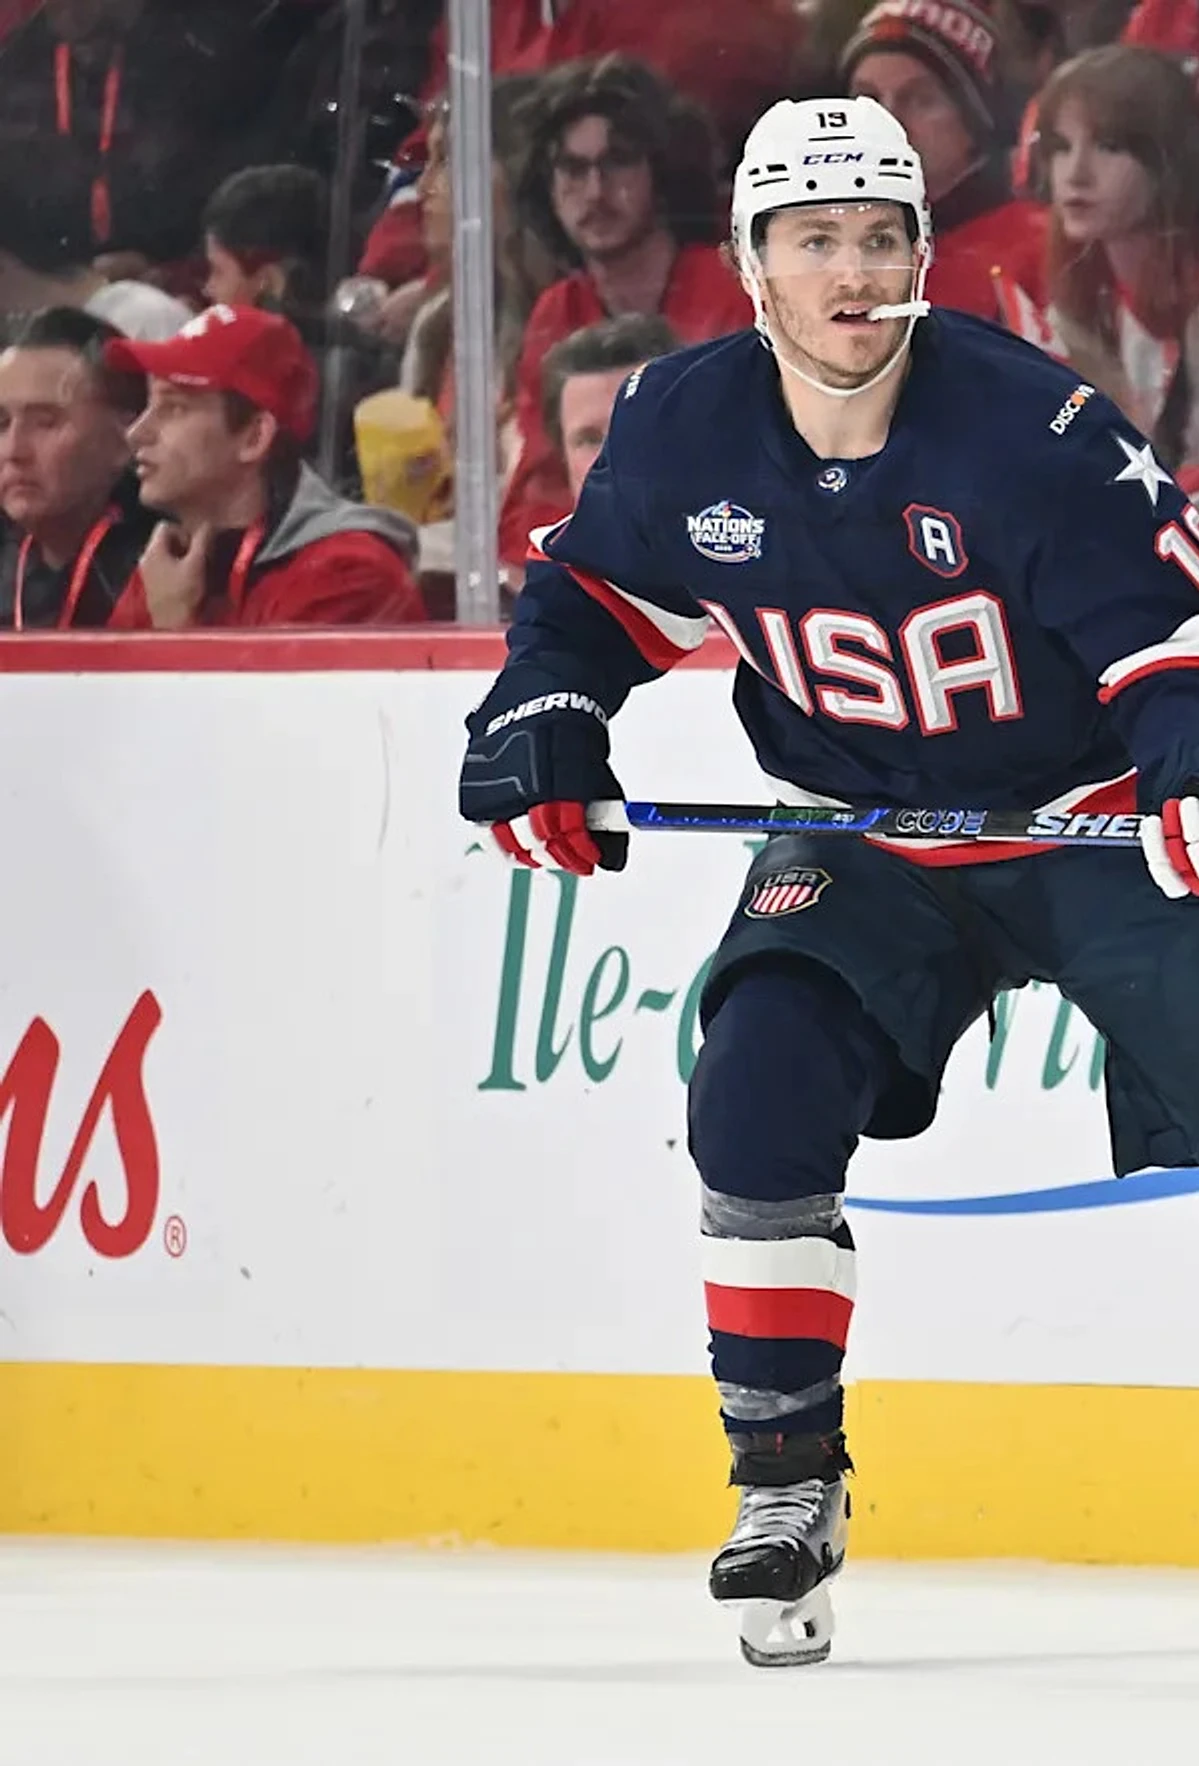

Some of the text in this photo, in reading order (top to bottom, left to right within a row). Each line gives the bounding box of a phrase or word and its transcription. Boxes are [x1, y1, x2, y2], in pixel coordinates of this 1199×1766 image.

[803, 152, 864, 165] CCM
[687, 516, 765, 533] NATIONS
[695, 531, 757, 544] FACE-OFF
[921, 516, 956, 565] A
[485, 692, 609, 736] SHERWO
[764, 871, 818, 888] USA
